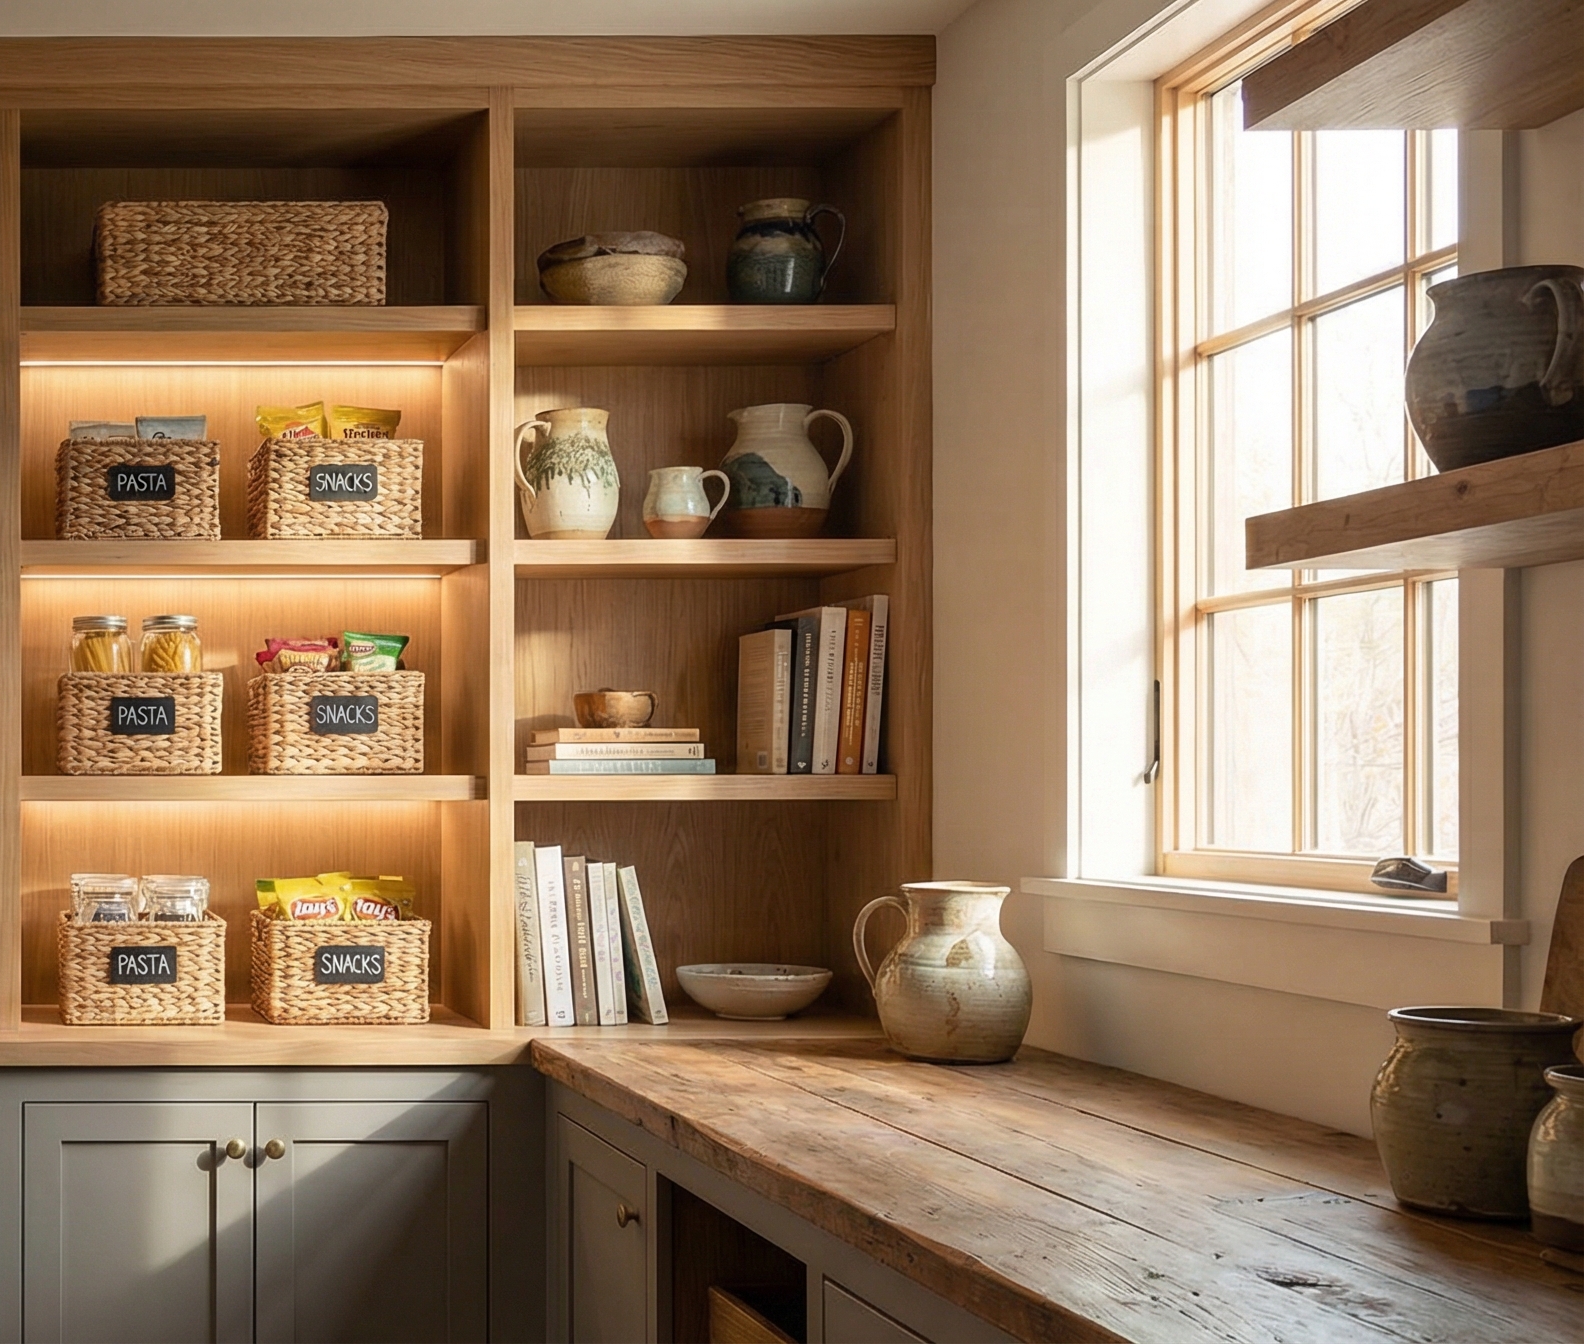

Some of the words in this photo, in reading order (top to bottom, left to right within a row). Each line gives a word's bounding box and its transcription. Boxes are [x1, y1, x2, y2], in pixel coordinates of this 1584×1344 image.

[117, 473, 167, 492] PASTA
[316, 473, 373, 492] SNACKS
[118, 705, 168, 726] PASTA
[316, 704, 375, 724] SNACKS
[118, 954, 171, 976] PASTA
[321, 953, 382, 975] SNACKS
